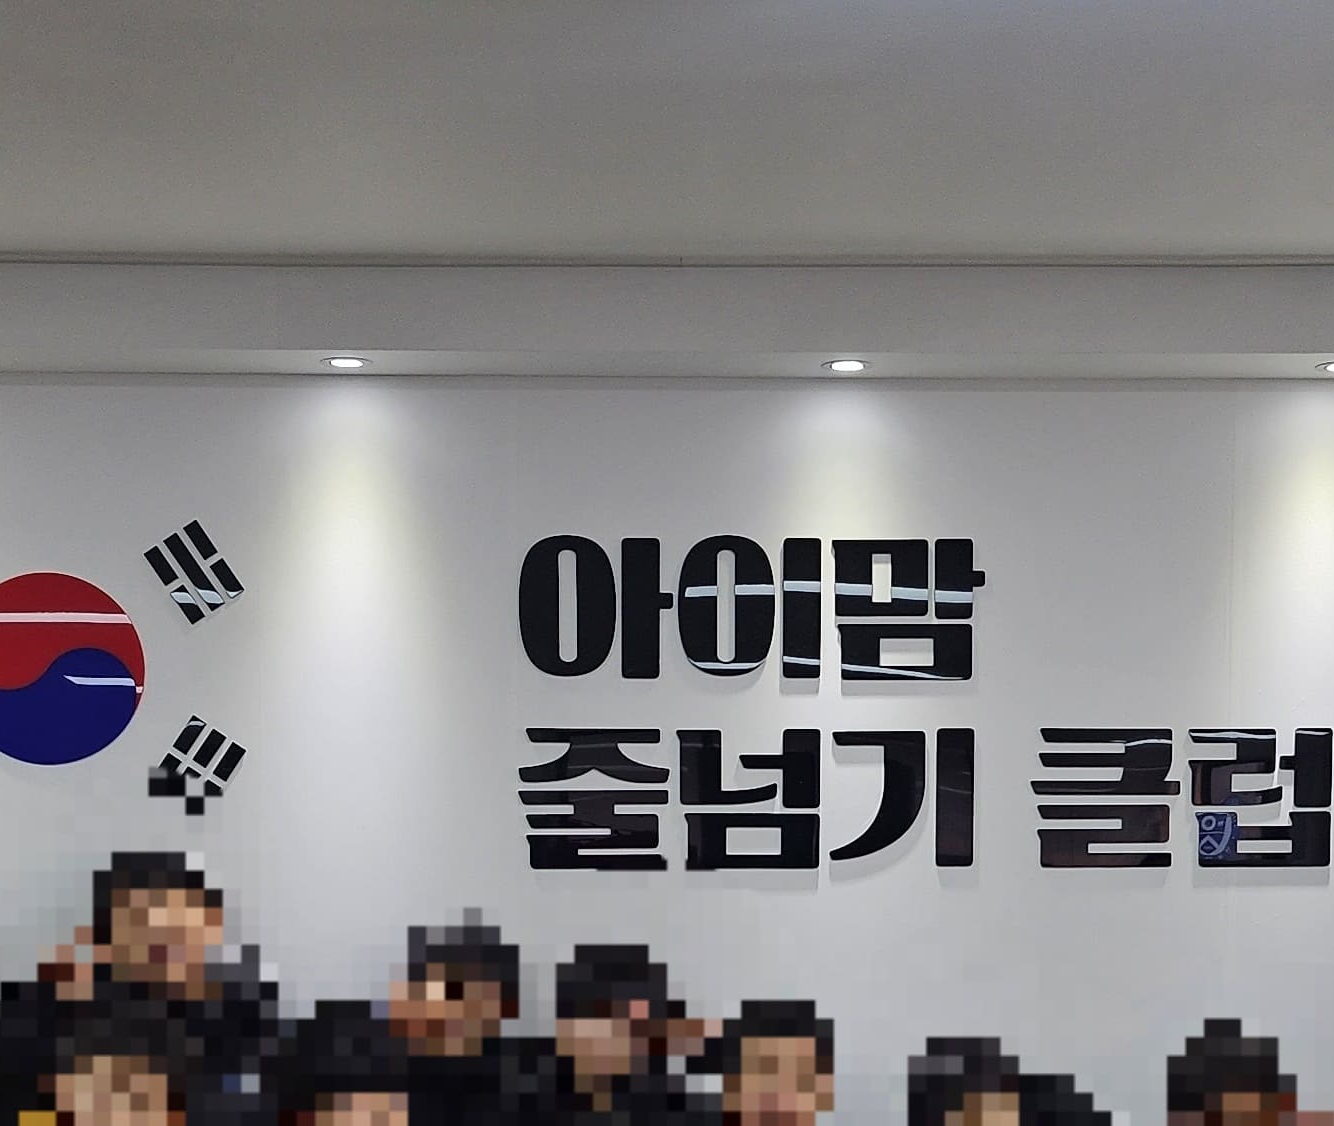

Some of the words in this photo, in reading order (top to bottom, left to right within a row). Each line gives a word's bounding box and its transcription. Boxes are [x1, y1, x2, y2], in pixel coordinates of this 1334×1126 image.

[518, 535, 985, 681] 아이맘
[518, 728, 975, 869] 줄넘기
[1031, 728, 1333, 868] 클럽
